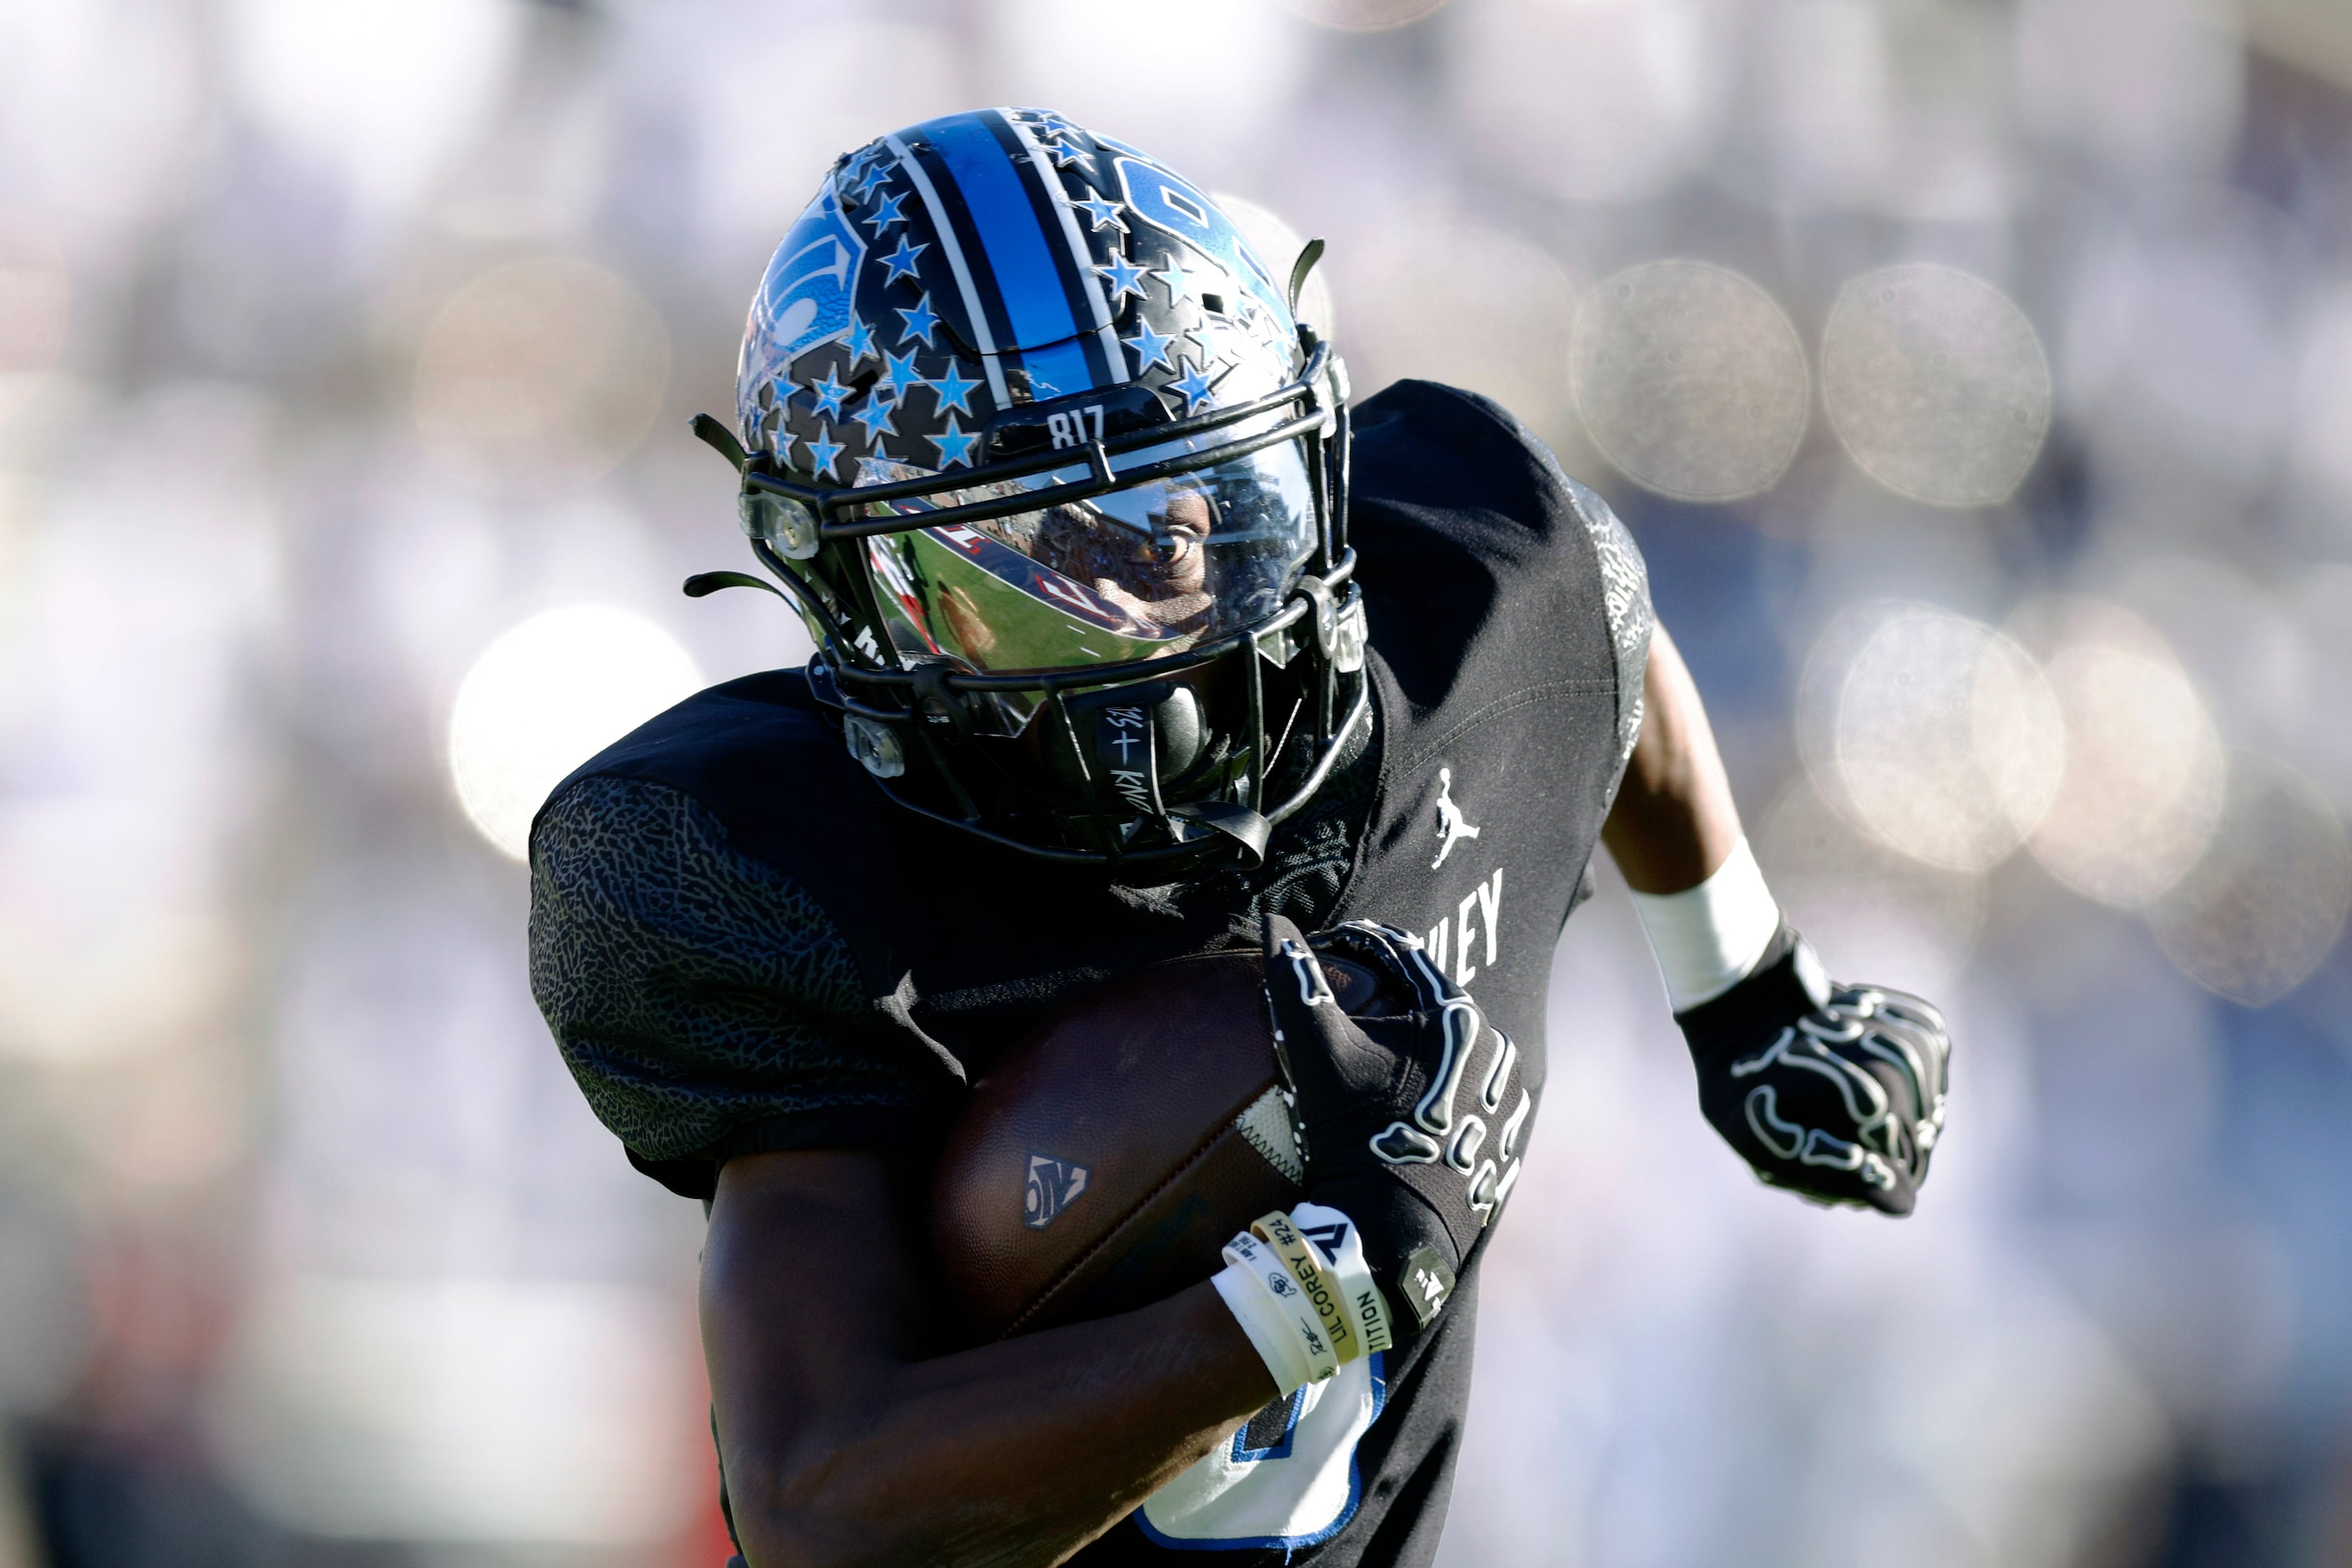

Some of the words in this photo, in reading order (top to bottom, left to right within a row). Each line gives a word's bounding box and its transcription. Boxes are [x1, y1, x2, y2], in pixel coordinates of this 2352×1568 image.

[1047, 404, 1104, 449] 817
[1269, 1219, 1297, 1247] #24
[1290, 1256, 1334, 1317] COREY
[1328, 1316, 1348, 1343] LIL
